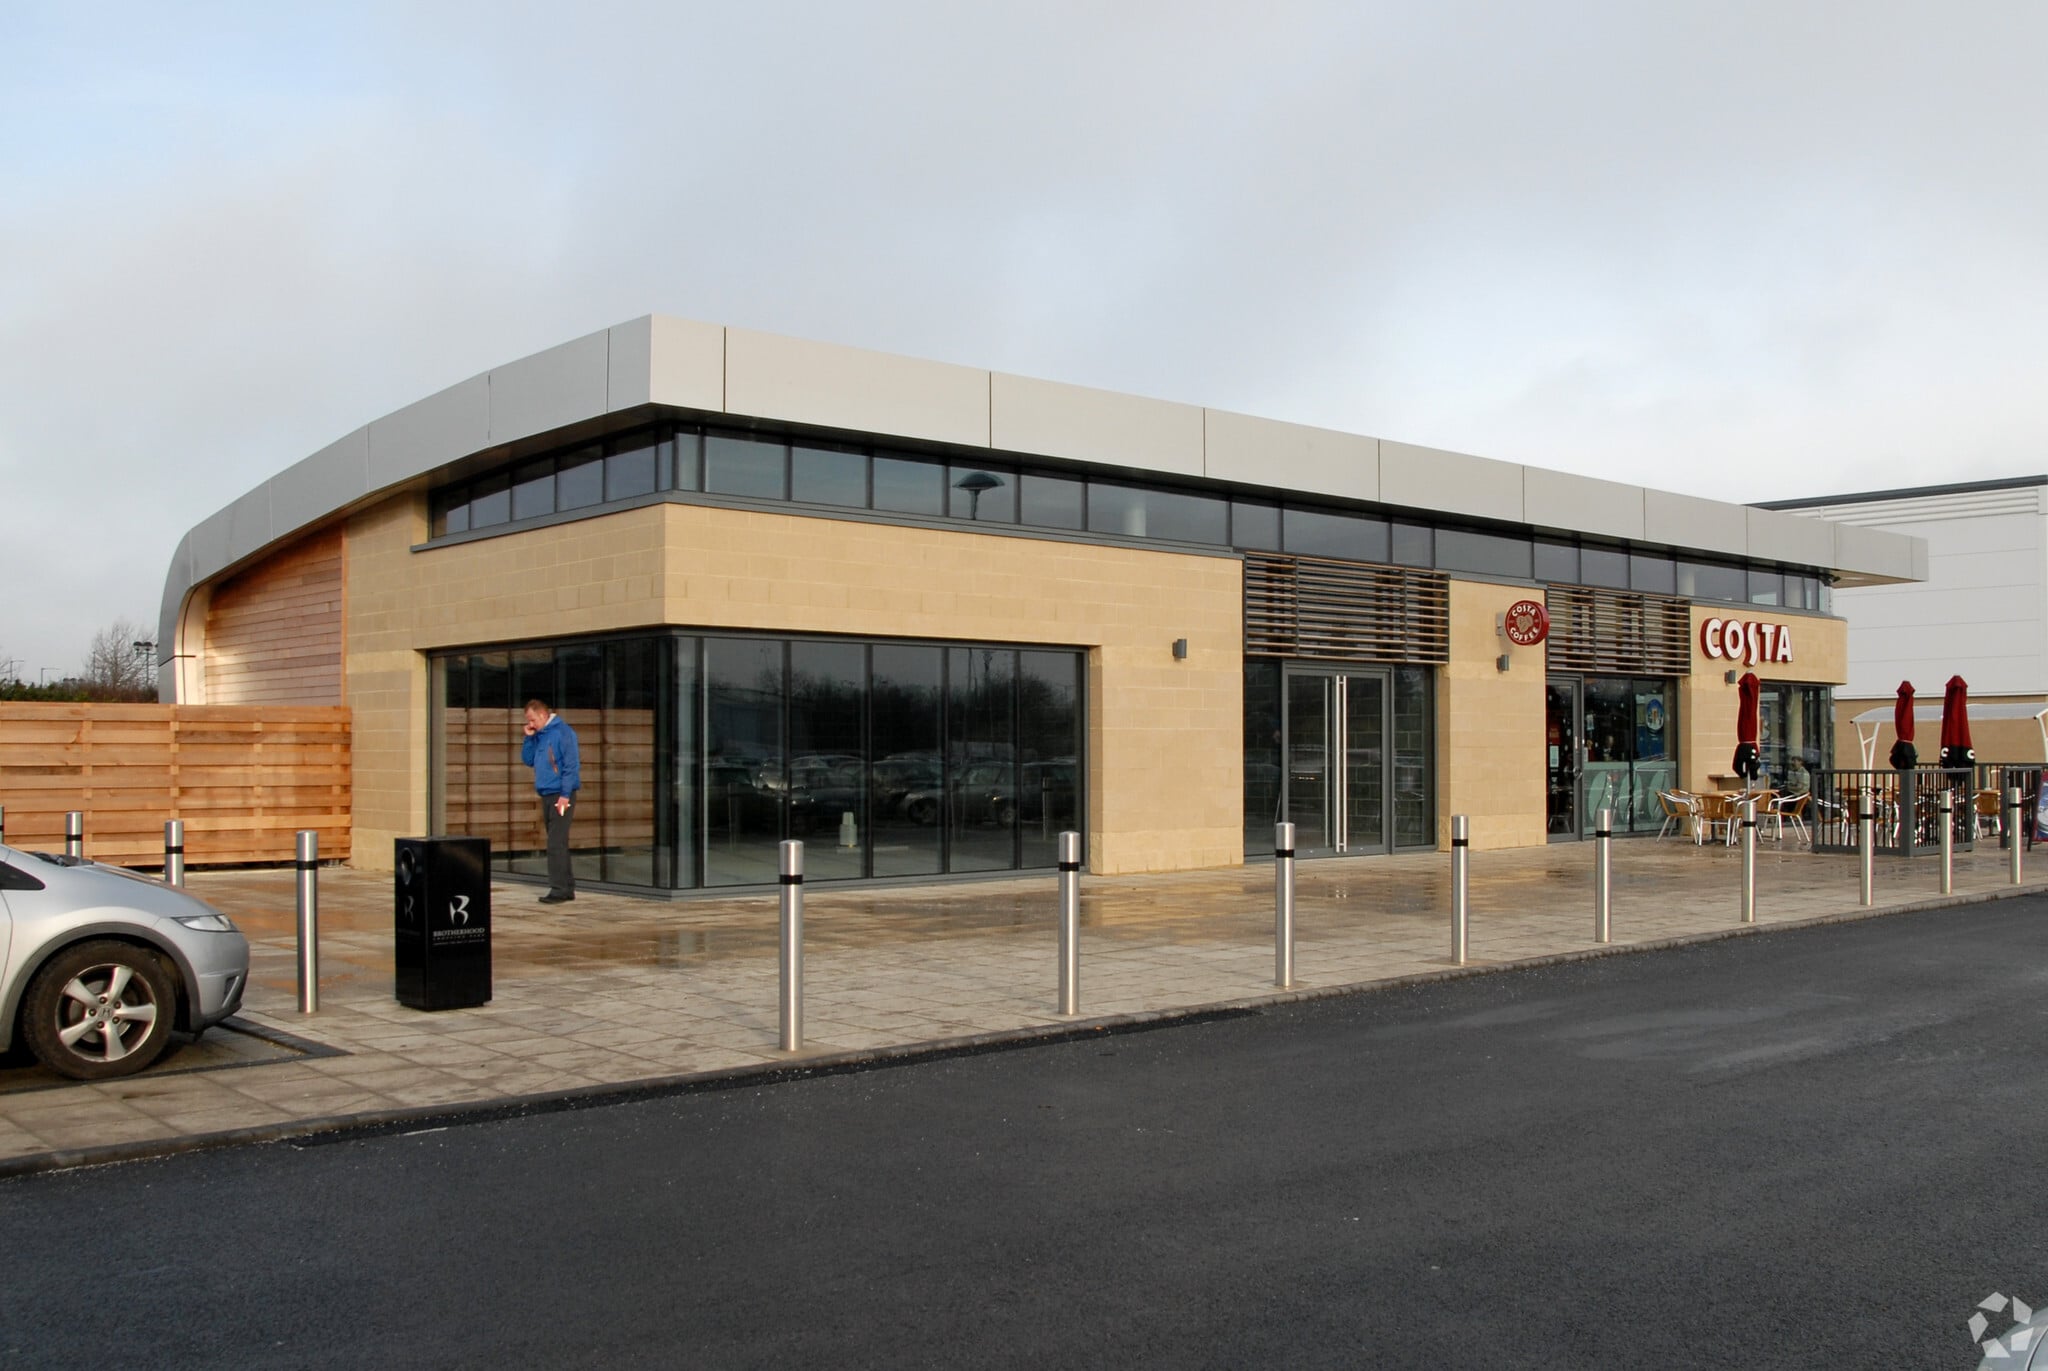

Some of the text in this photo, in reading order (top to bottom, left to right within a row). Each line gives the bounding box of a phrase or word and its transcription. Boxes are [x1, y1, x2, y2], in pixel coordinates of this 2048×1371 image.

[1512, 605, 1535, 616] COSTA
[1510, 627, 1538, 640] COFFEE
[1700, 618, 1793, 667] COSTA
